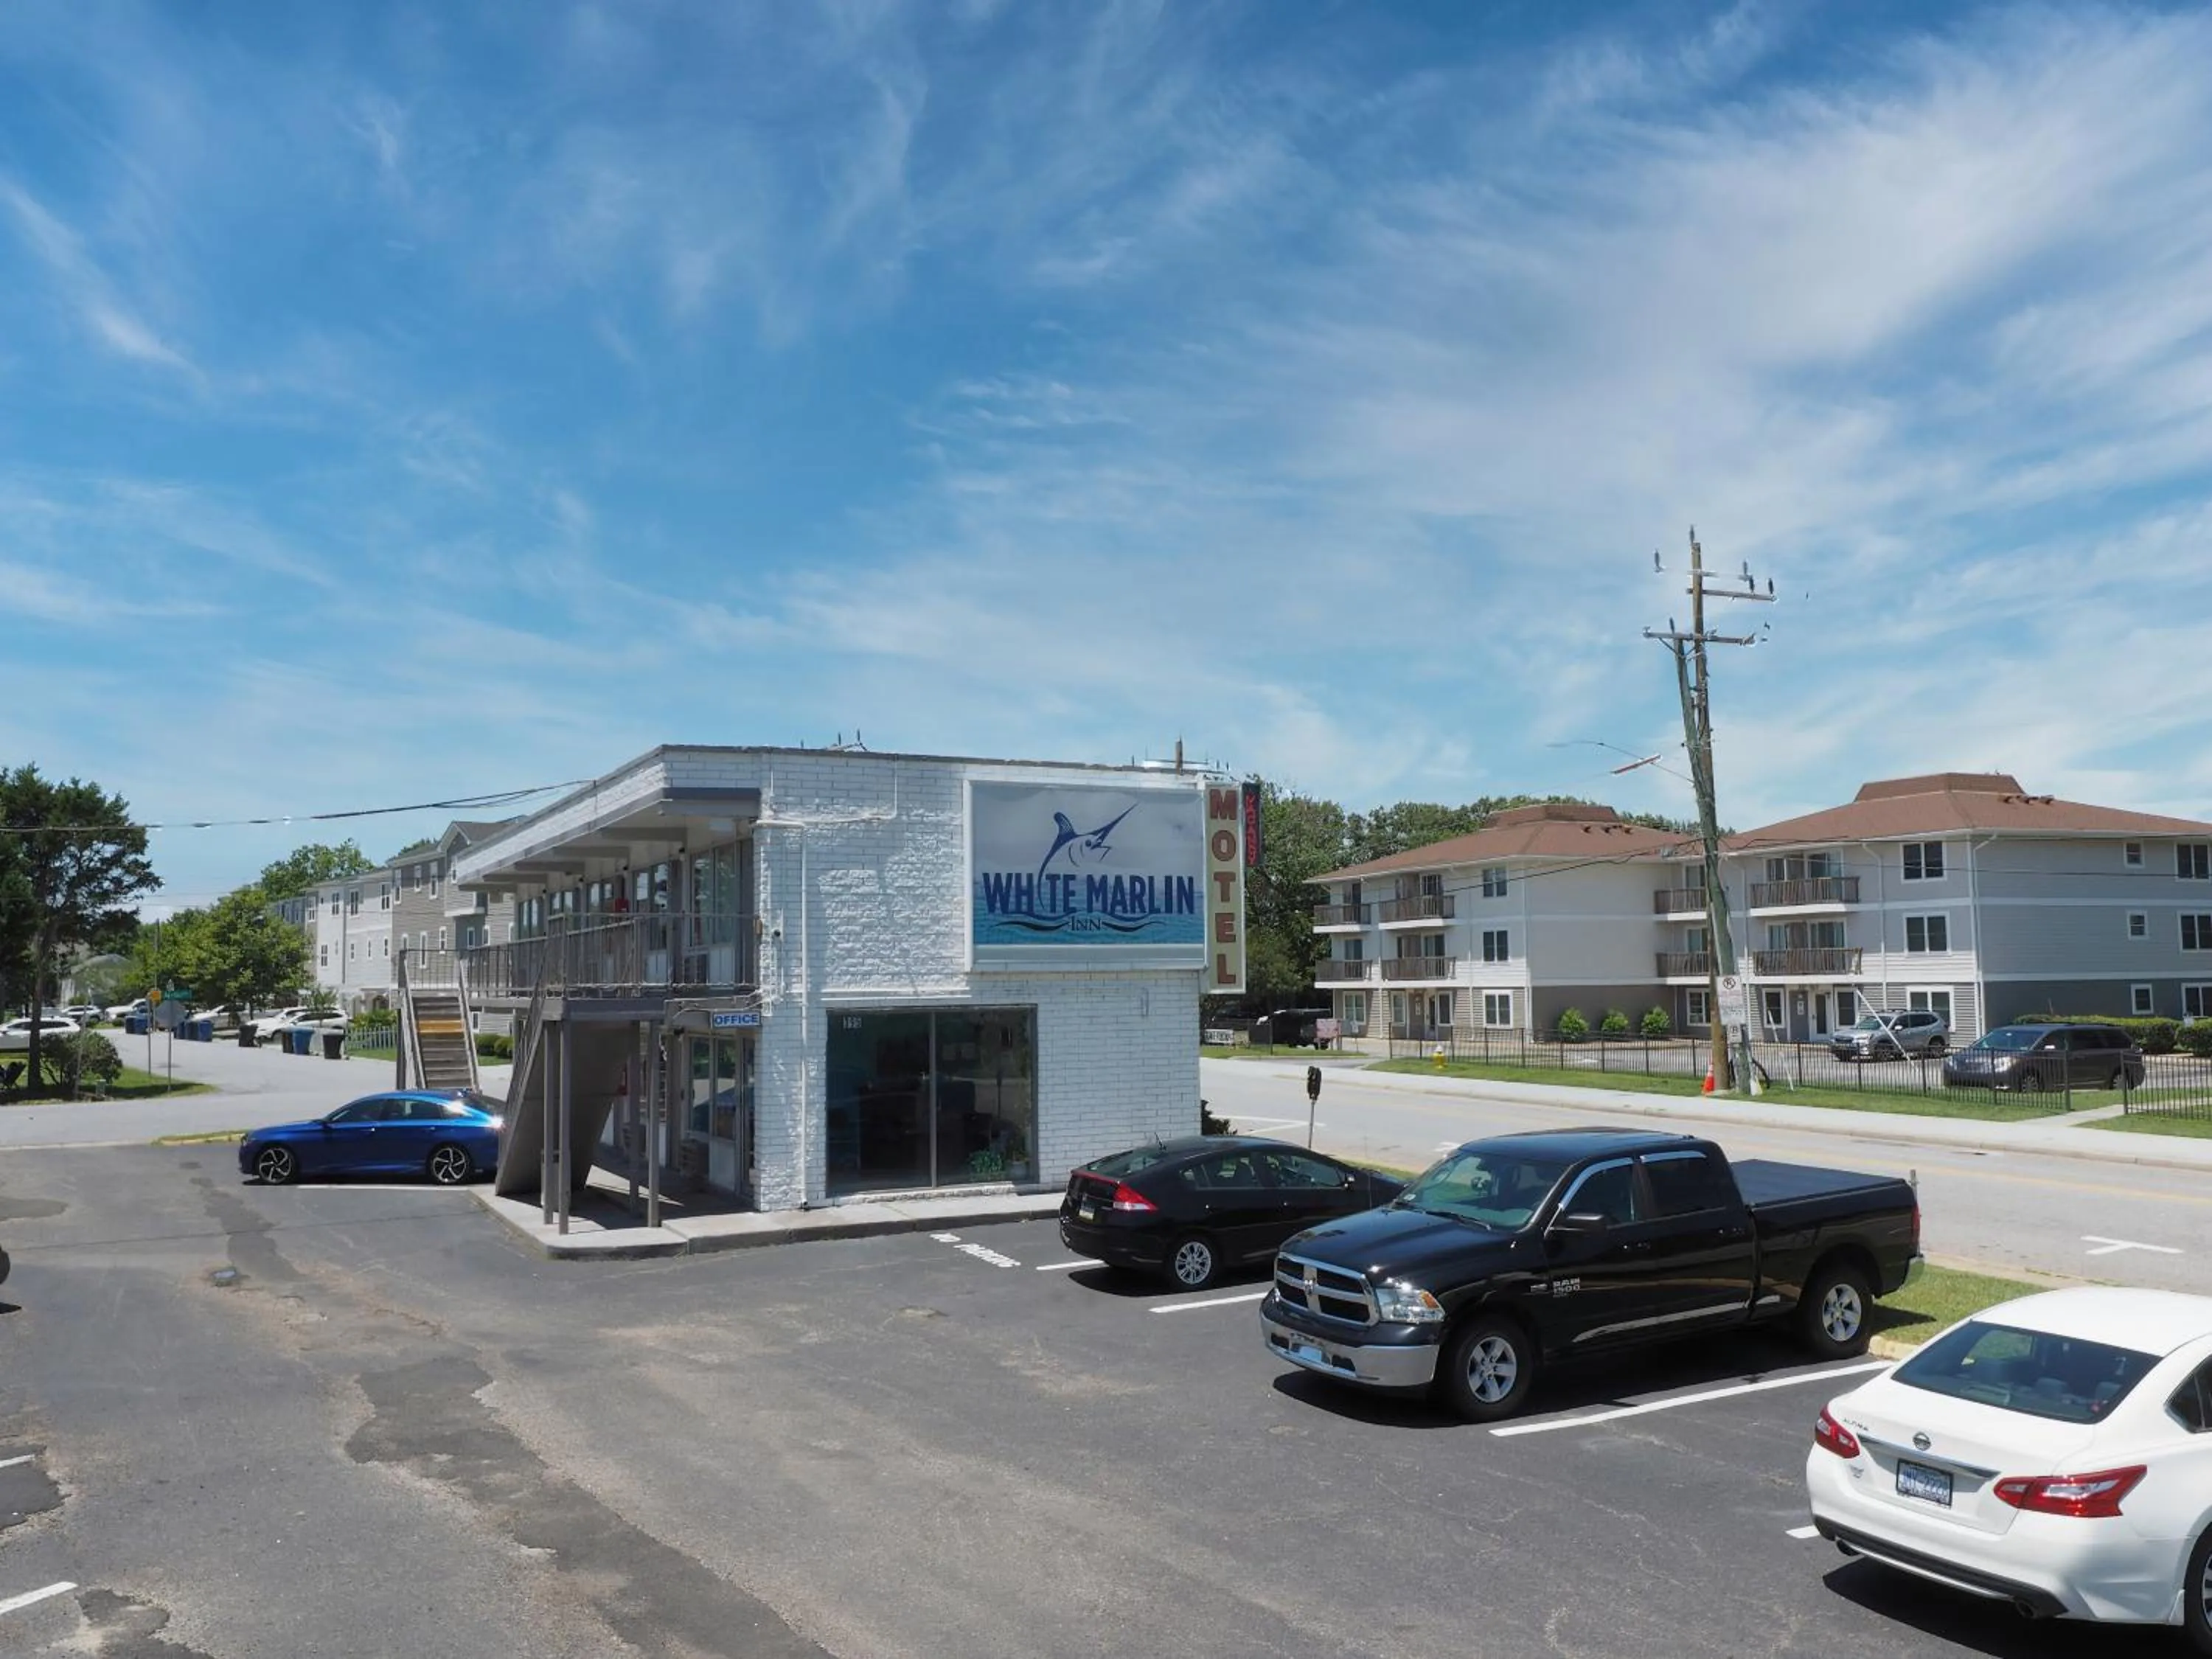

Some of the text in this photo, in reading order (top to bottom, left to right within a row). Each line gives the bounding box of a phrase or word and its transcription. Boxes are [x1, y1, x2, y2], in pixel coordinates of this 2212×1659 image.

[982, 872, 1194, 915] WHITE MARLIN
[1209, 789, 1237, 984] MOTEL
[1071, 916, 1102, 931] INN
[714, 1013, 759, 1026] OFFICE
